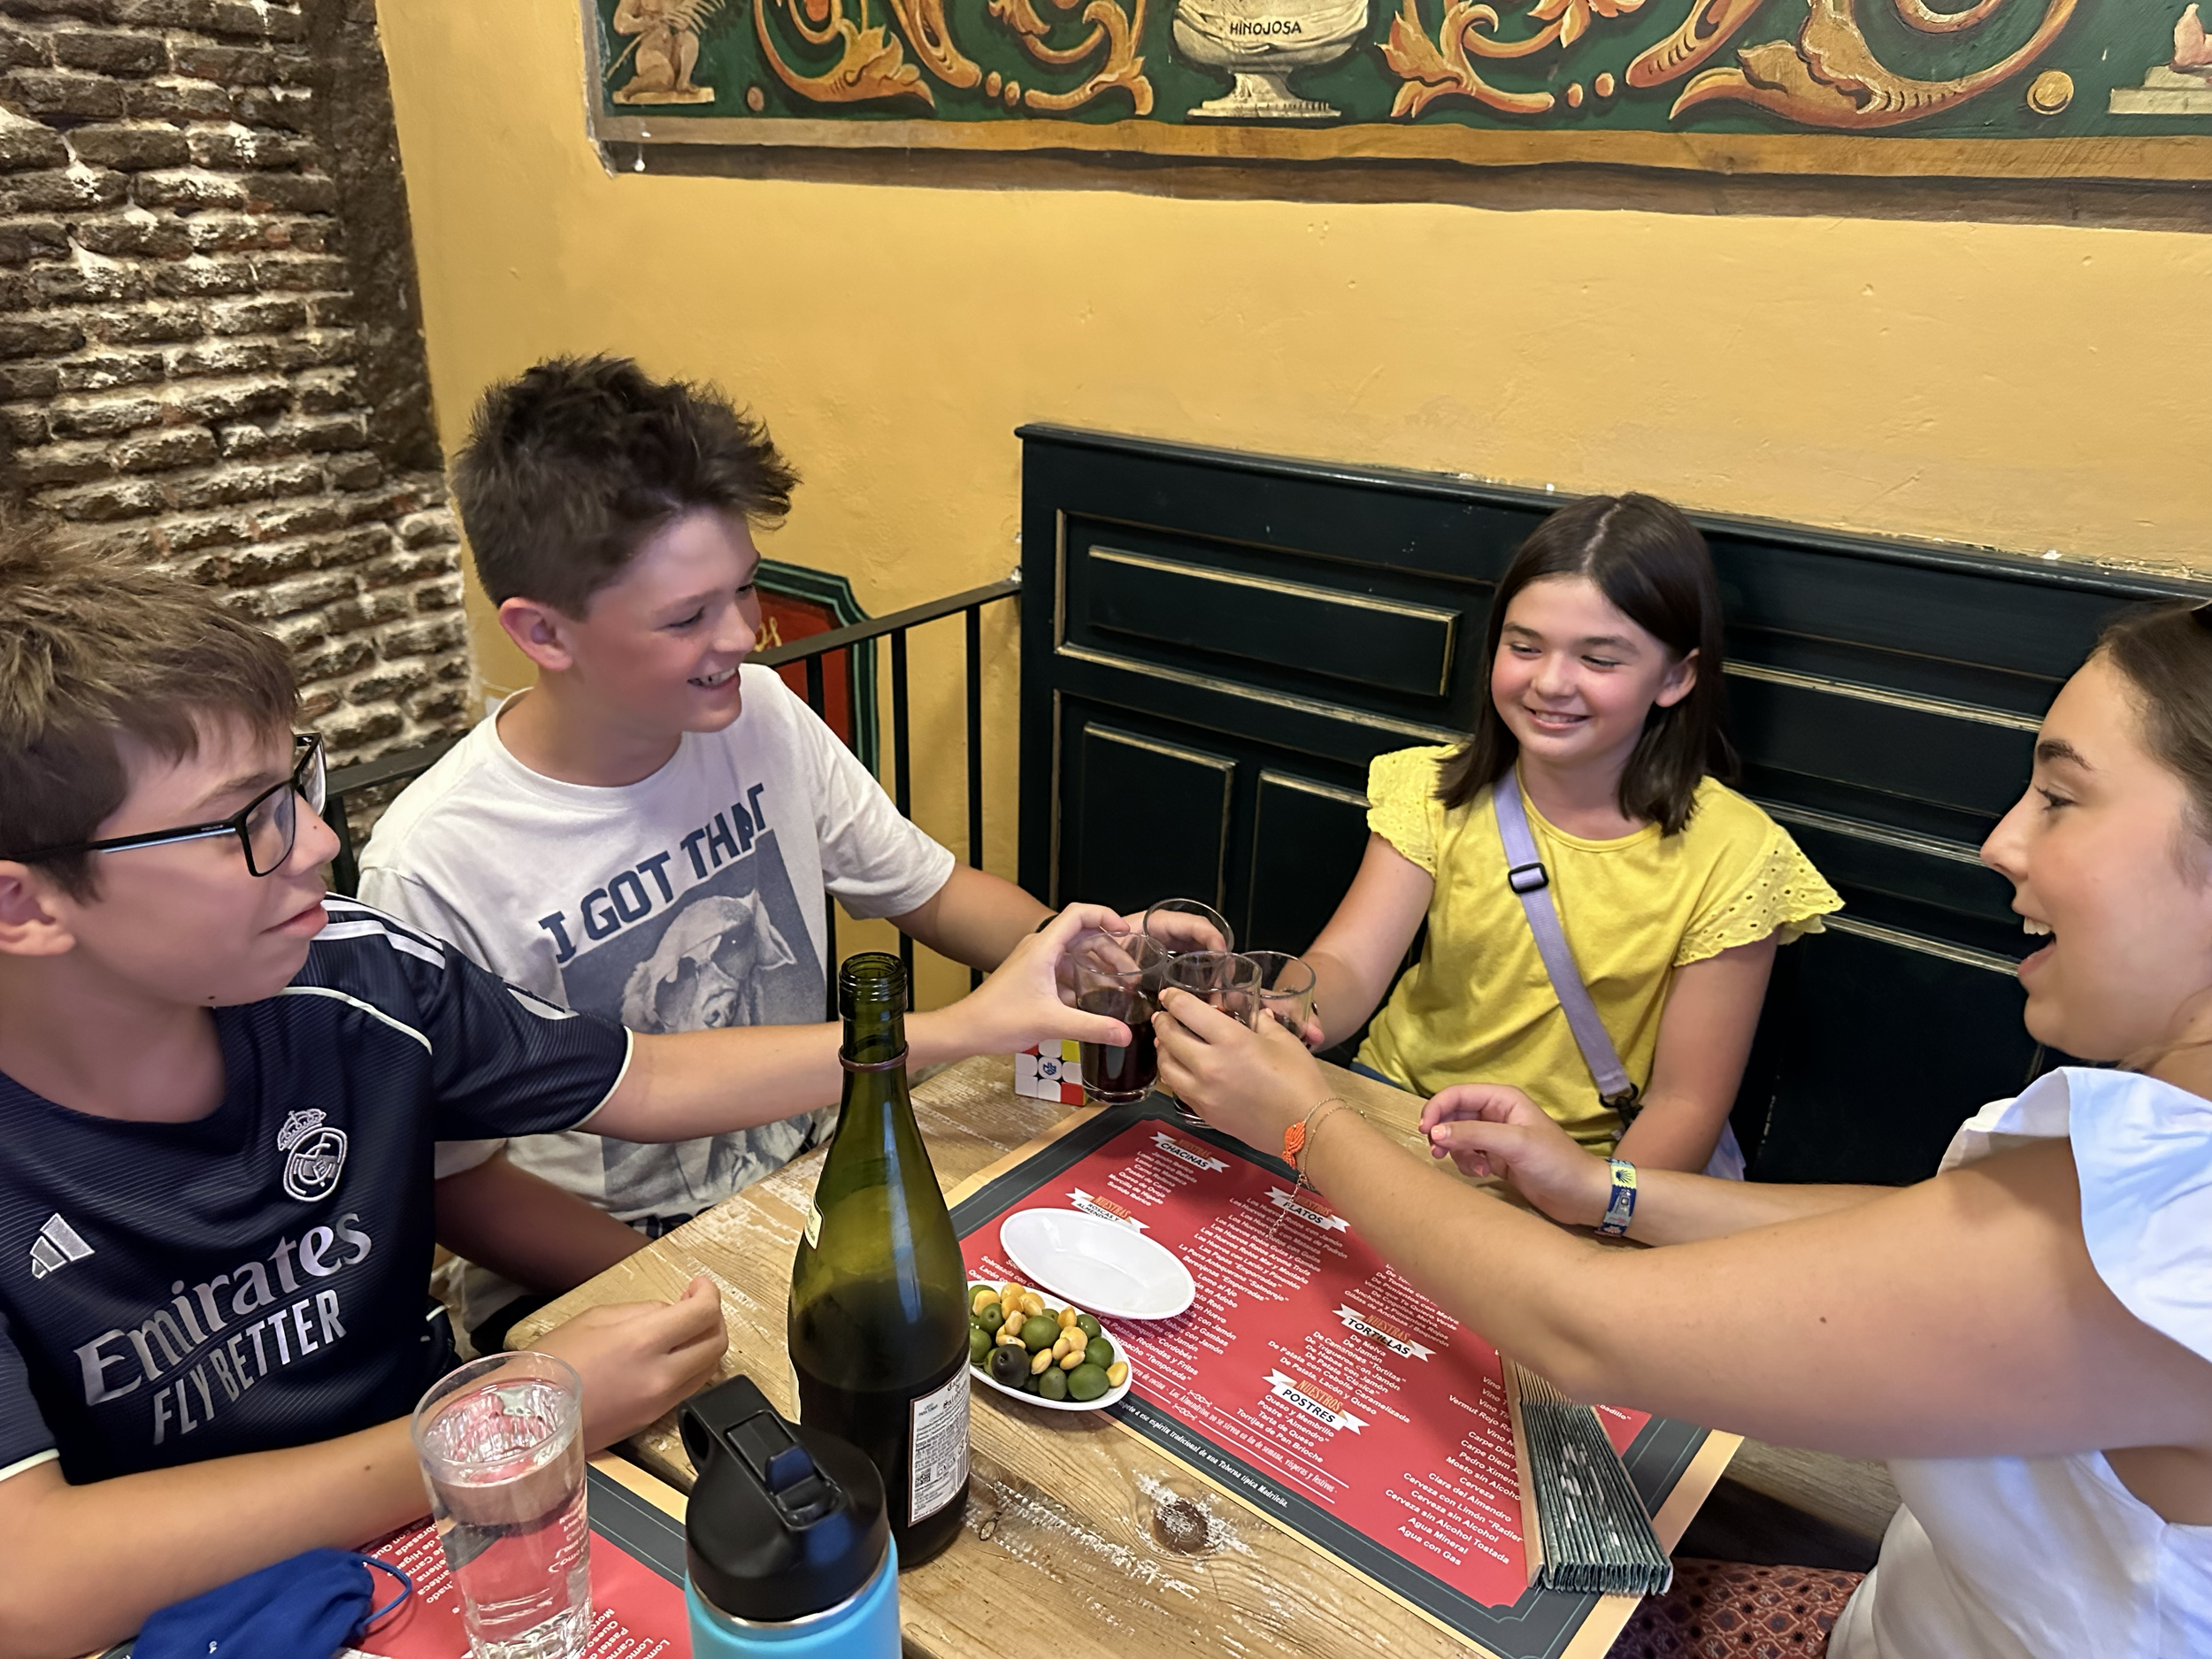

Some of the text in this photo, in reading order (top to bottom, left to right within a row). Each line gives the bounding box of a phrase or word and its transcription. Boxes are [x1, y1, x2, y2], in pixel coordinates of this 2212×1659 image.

[1230, 21, 1302, 35] HINOJOSA
[539, 911, 577, 963] I
[580, 850, 673, 941] GOT
[1160, 1142, 1209, 1168] CHACINAS
[1087, 1203, 1114, 1219] ROSCAS
[1094, 1195, 1132, 1218] NUESTRAS
[1282, 1202, 1324, 1224] PLATOS
[1194, 1233, 1207, 1242] Los
[1206, 1240, 1231, 1255] Huevos
[1230, 1252, 1243, 1261] con
[1243, 1258, 1263, 1271] Lacón
[1269, 1271, 1301, 1290] Pimentón
[1198, 1244, 1282, 1287] Las Papas “Emporradas”
[1200, 1226, 1214, 1237] Los
[1213, 1233, 1239, 1249] Huevos
[1238, 1246, 1259, 1260] Rotos
[1258, 1256, 1273, 1266] Mar
[1278, 1266, 1309, 1285] Montaña
[1210, 1223, 1310, 1276] Los Huevos Rotos Aroma Trufa
[979, 1264, 1000, 1279] Lacón
[1182, 1255, 1270, 1301] Berenjenas “Emporradas”
[1187, 1248, 1206, 1261] Porra
[1205, 1258, 1247, 1282] Antequerana
[1248, 1279, 1289, 1302] “Salmorejo”
[1197, 1272, 1217, 1286] Lomo
[1224, 1287, 1238, 1297] Ajo
[74, 1213, 372, 1407] Emirates
[1203, 1308, 1227, 1324] Huevo
[1213, 1293, 1238, 1308] Adobo
[1173, 1336, 1199, 1352] Jamón
[1184, 1331, 1224, 1355] con Jamón
[1197, 1317, 1237, 1340] con Jamón
[1199, 1327, 1229, 1347] Gambas
[1348, 1318, 1410, 1355] TORTILLAS
[1365, 1315, 1410, 1341] NUESTRAS
[1136, 1337, 1171, 1360] Redondas
[1177, 1360, 1199, 1376] Fritas
[1312, 1331, 1406, 1382] De Camarones “Tortitas”
[1342, 1339, 1383, 1363] De Jamón
[1349, 1334, 1386, 1356] De Melva
[153, 1289, 348, 1445] FLY BETTER
[1146, 1353, 1192, 1381] “Temporada”
[1304, 1351, 1341, 1376] De Patata
[1305, 1344, 1388, 1394] De Habas con Jamón
[1268, 1340, 1410, 1423] De Patata con Cebolla Caramelizada
[1279, 1356, 1292, 1366] De
[1291, 1363, 1317, 1381] Patata,
[1318, 1378, 1344, 1395] Lacón
[1350, 1396, 1377, 1415] Queso
[1296, 1380, 1343, 1411] NUESTROS
[1482, 1388, 1501, 1402] Vino
[1483, 1376, 1502, 1390] Vino
[1257, 1400, 1330, 1442] Postre “Almendro”
[1264, 1394, 1290, 1411] Queso
[1295, 1412, 1334, 1437] Membrillo
[1282, 1389, 1336, 1423] POSTRES
[1449, 1394, 1499, 1425] Vermut Rojo
[1479, 1398, 1498, 1413] Vino
[1237, 1408, 1324, 1463] Torrijas de Pan Brioche
[1258, 1410, 1315, 1447] Tarta de Queso
[1468, 1431, 1494, 1448] Carpe
[1486, 1428, 1506, 1442] Vino
[1459, 1451, 1520, 1487] Pedro Ximene
[1461, 1440, 1510, 1470] Carpe Diem
[1446, 1456, 1522, 1501] Mosto sin Alcoho
[1459, 1477, 1494, 1500] Cerveza
[1403, 1472, 1438, 1496] Cerveza
[1439, 1494, 1456, 1507] con
[1456, 1503, 1486, 1523] Limón
[1428, 1472, 1511, 1522] Clara del Almendro
[1386, 1489, 1509, 1564] Cerveza sin Alcohol Tostada
[1411, 1490, 1499, 1542] Cerveza sin Alcohol
[395, 1522, 437, 1555] obrasada
[1397, 1525, 1462, 1565] Agua con Gas
[1408, 1517, 1469, 1555] Agua Mineral
[587, 1620, 618, 1647] Queso
[597, 1627, 629, 1655] Pastel
